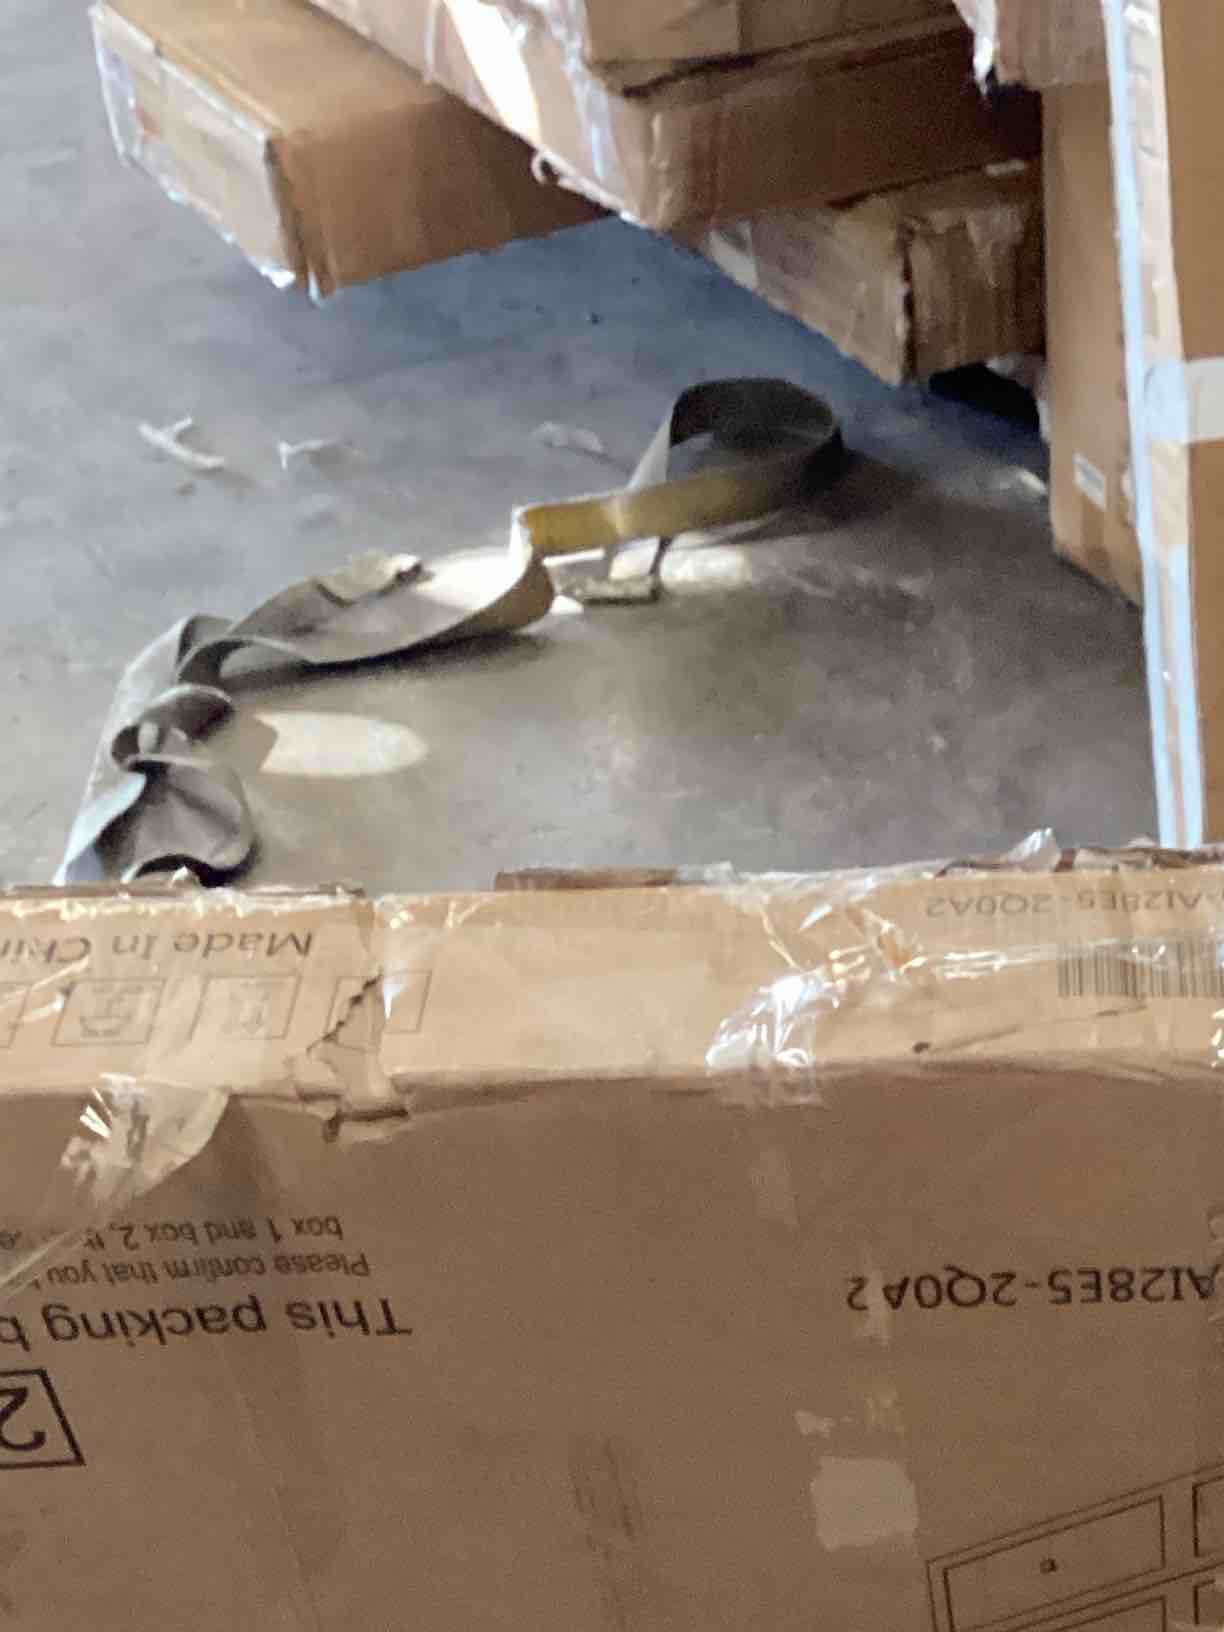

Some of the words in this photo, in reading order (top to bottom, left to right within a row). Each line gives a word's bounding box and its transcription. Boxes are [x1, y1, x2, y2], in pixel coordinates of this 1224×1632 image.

[112, 934, 159, 962] In
[173, 931, 313, 961] Made
[144, 1221, 199, 1249] box
[203, 1220, 257, 1246] and
[266, 1217, 283, 1245] 1
[290, 1215, 344, 1242] box
[47, 1259, 101, 1285] you
[102, 1259, 160, 1286] that
[162, 1255, 266, 1282] confirm
[273, 1252, 372, 1279] Please
[40, 1294, 269, 1349] packing
[285, 1297, 413, 1338] This
[0, 1386, 47, 1453] 2
